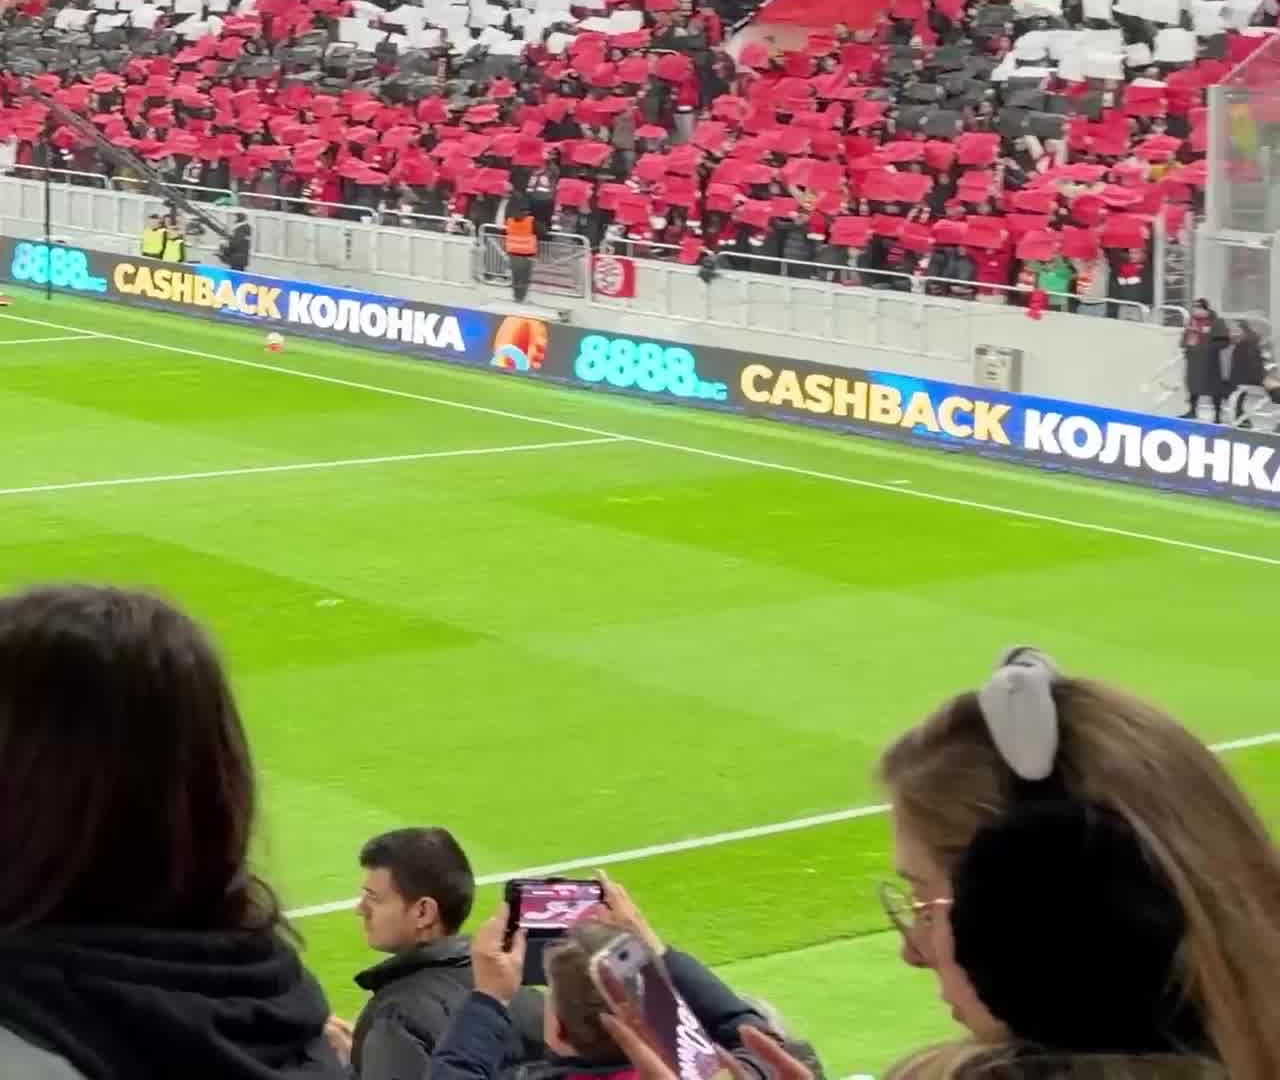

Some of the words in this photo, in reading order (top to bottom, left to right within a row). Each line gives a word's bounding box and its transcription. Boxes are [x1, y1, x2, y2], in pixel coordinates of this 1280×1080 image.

[112, 262, 282, 320] CASHBACK
[288, 291, 466, 353] КОЛОНКА
[740, 363, 1011, 447] CASHBACK
[1023, 408, 1280, 492] КОЛОНК
